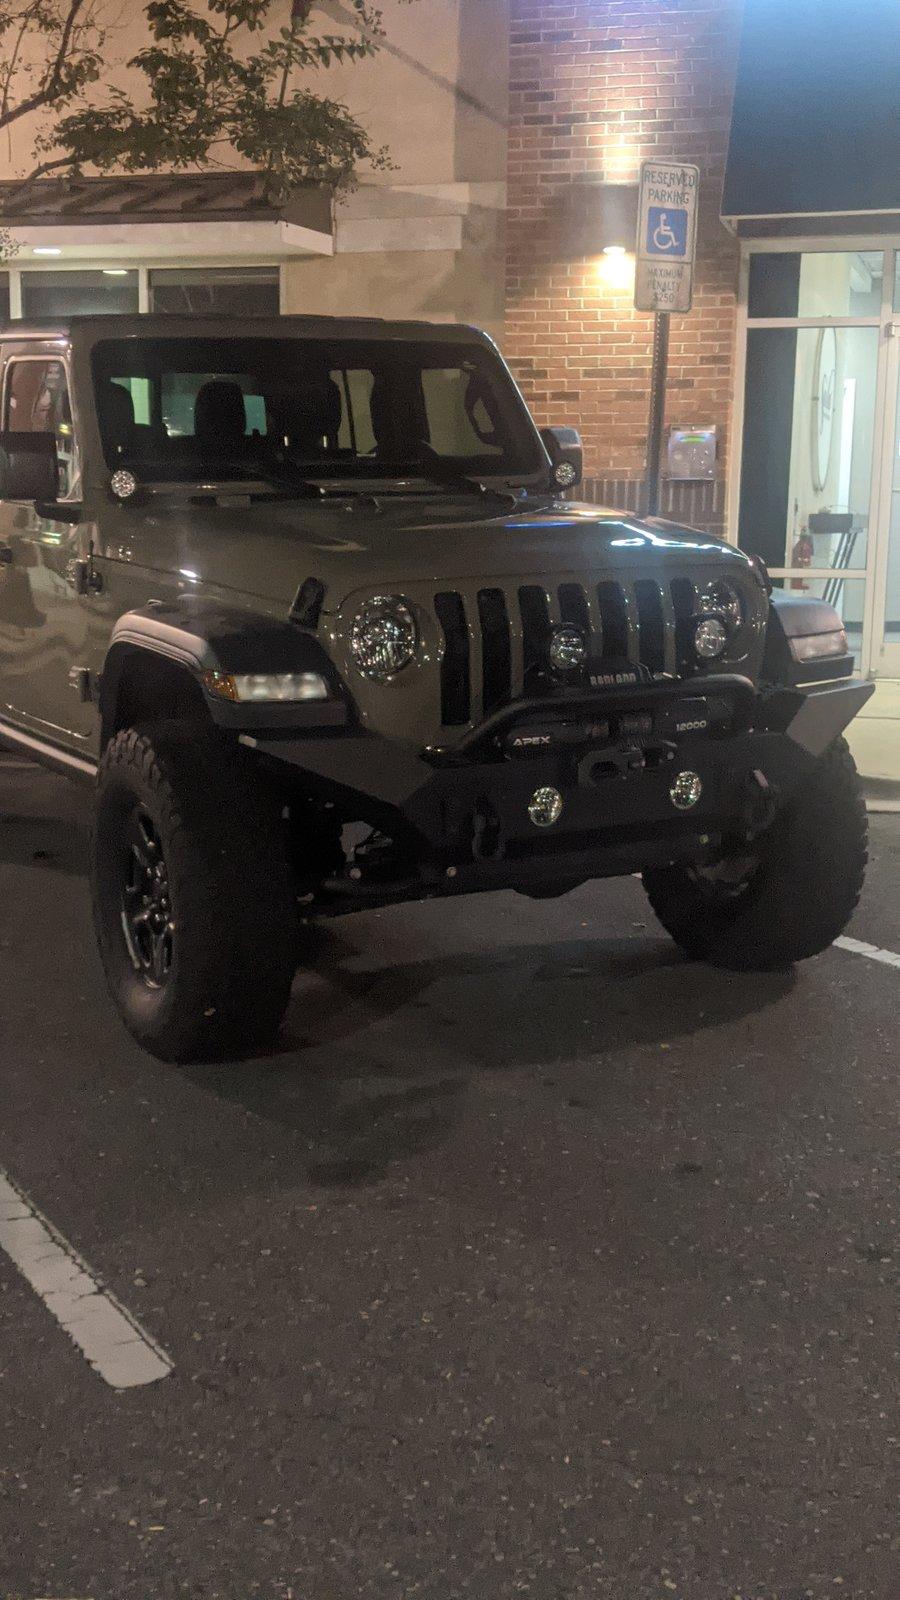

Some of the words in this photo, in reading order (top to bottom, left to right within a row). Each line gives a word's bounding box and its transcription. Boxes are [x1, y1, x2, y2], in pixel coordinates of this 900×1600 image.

[644, 170, 695, 187] RESERVED
[648, 189, 690, 205] PARKING
[676, 720, 707, 732] 12000
[513, 735, 551, 747] APEX
